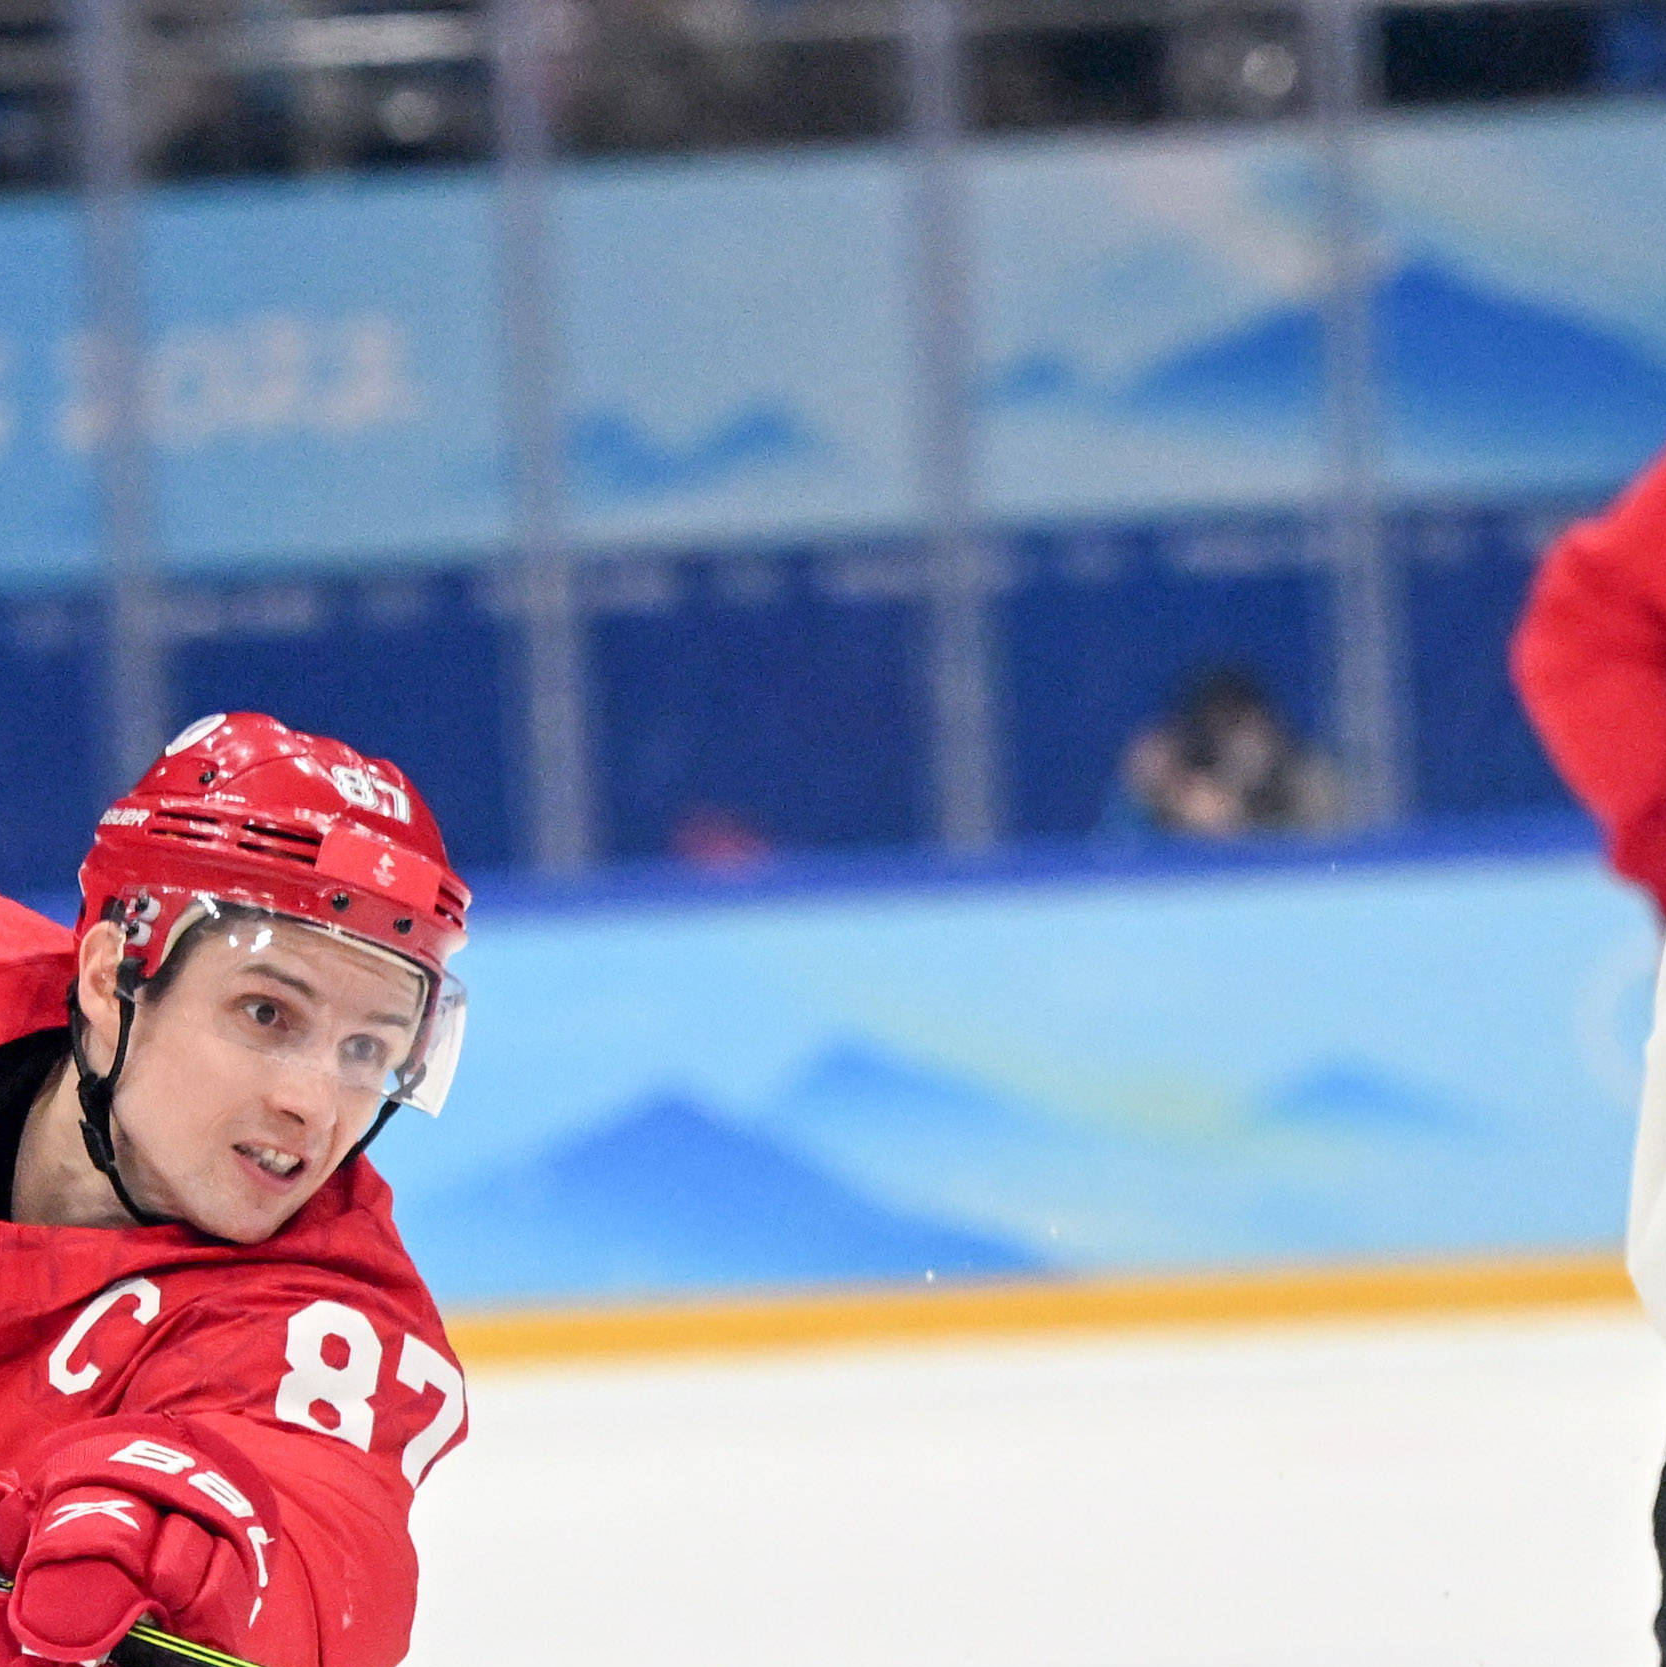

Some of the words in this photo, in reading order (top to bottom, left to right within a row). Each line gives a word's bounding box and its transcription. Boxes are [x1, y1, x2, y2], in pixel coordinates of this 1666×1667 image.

[331, 764, 411, 825] 87
[48, 1276, 161, 1395] C
[275, 1299, 465, 1491] 87
